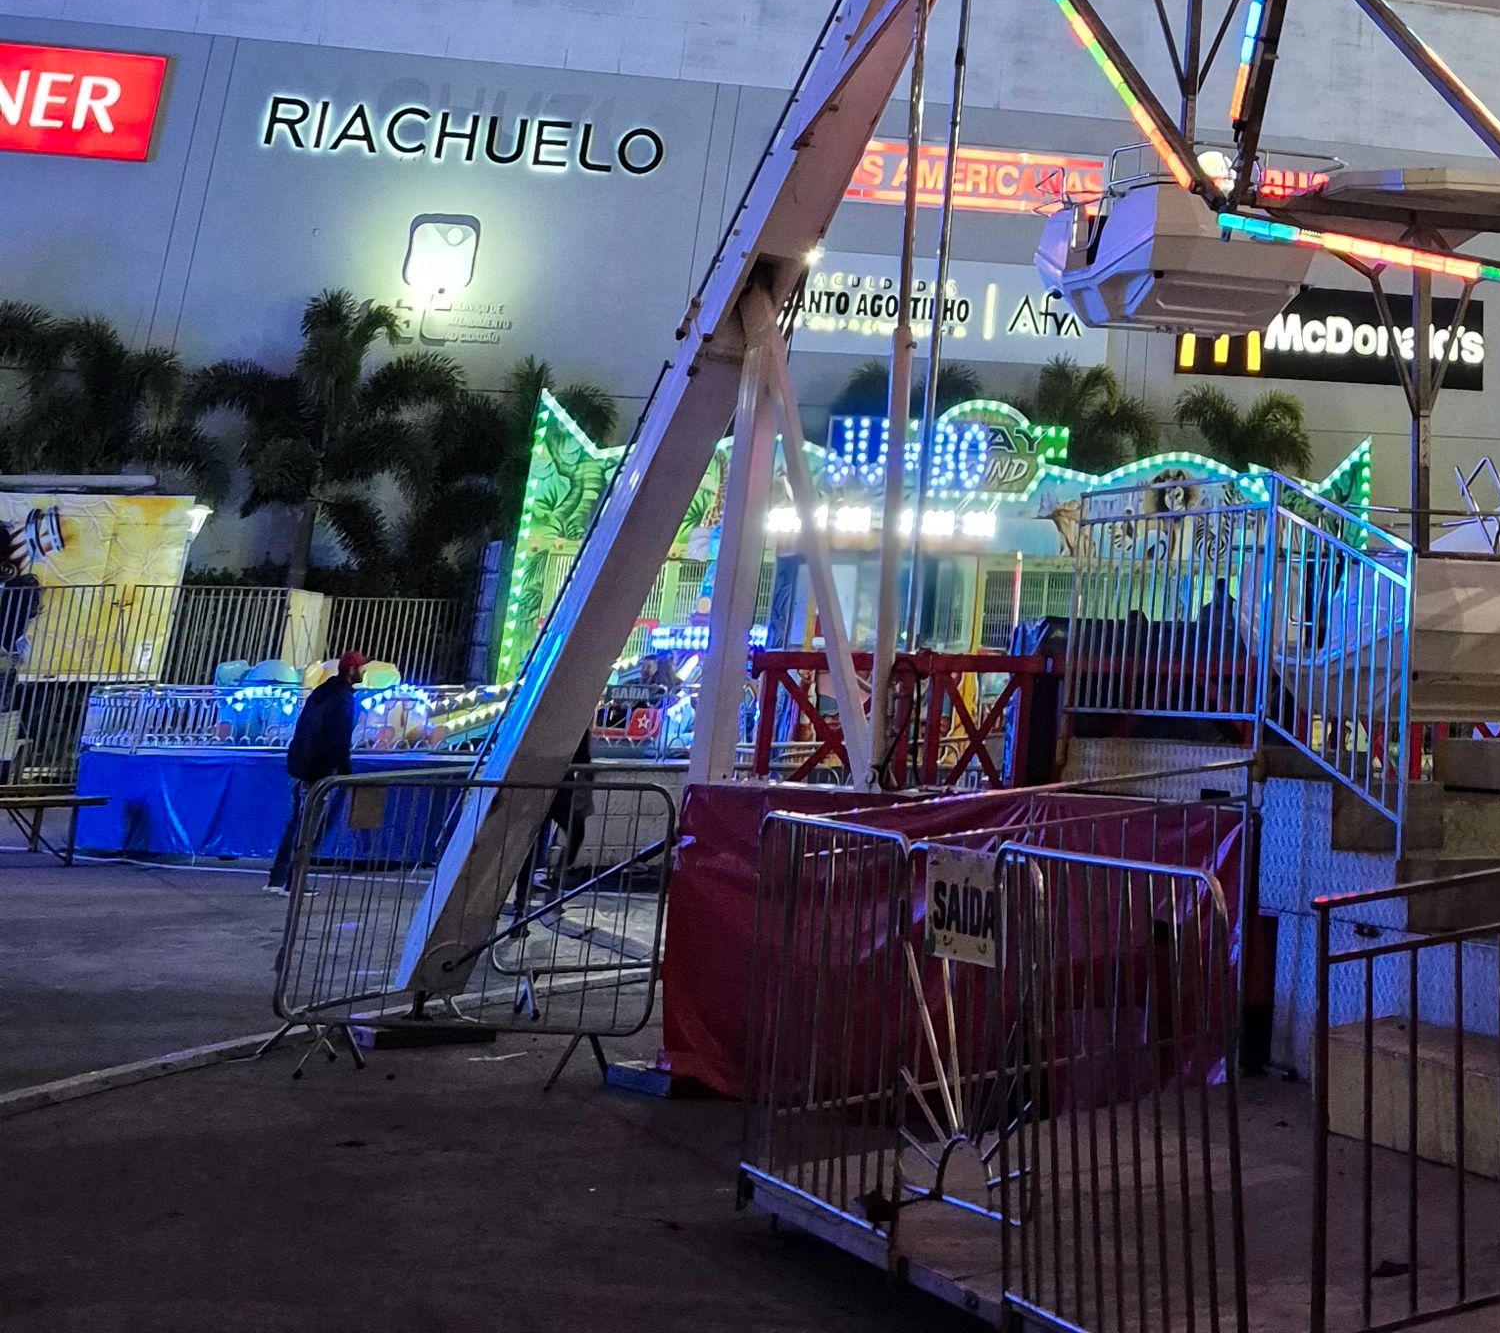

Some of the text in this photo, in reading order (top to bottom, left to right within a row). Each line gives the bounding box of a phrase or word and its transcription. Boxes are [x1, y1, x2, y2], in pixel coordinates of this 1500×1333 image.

[0, 69, 122, 133] NER
[263, 96, 664, 175] RIACHUELO
[797, 289, 970, 323] ANTO AGOTIHO
[823, 416, 990, 491] JUBO
[933, 876, 996, 940] SAÍDA
